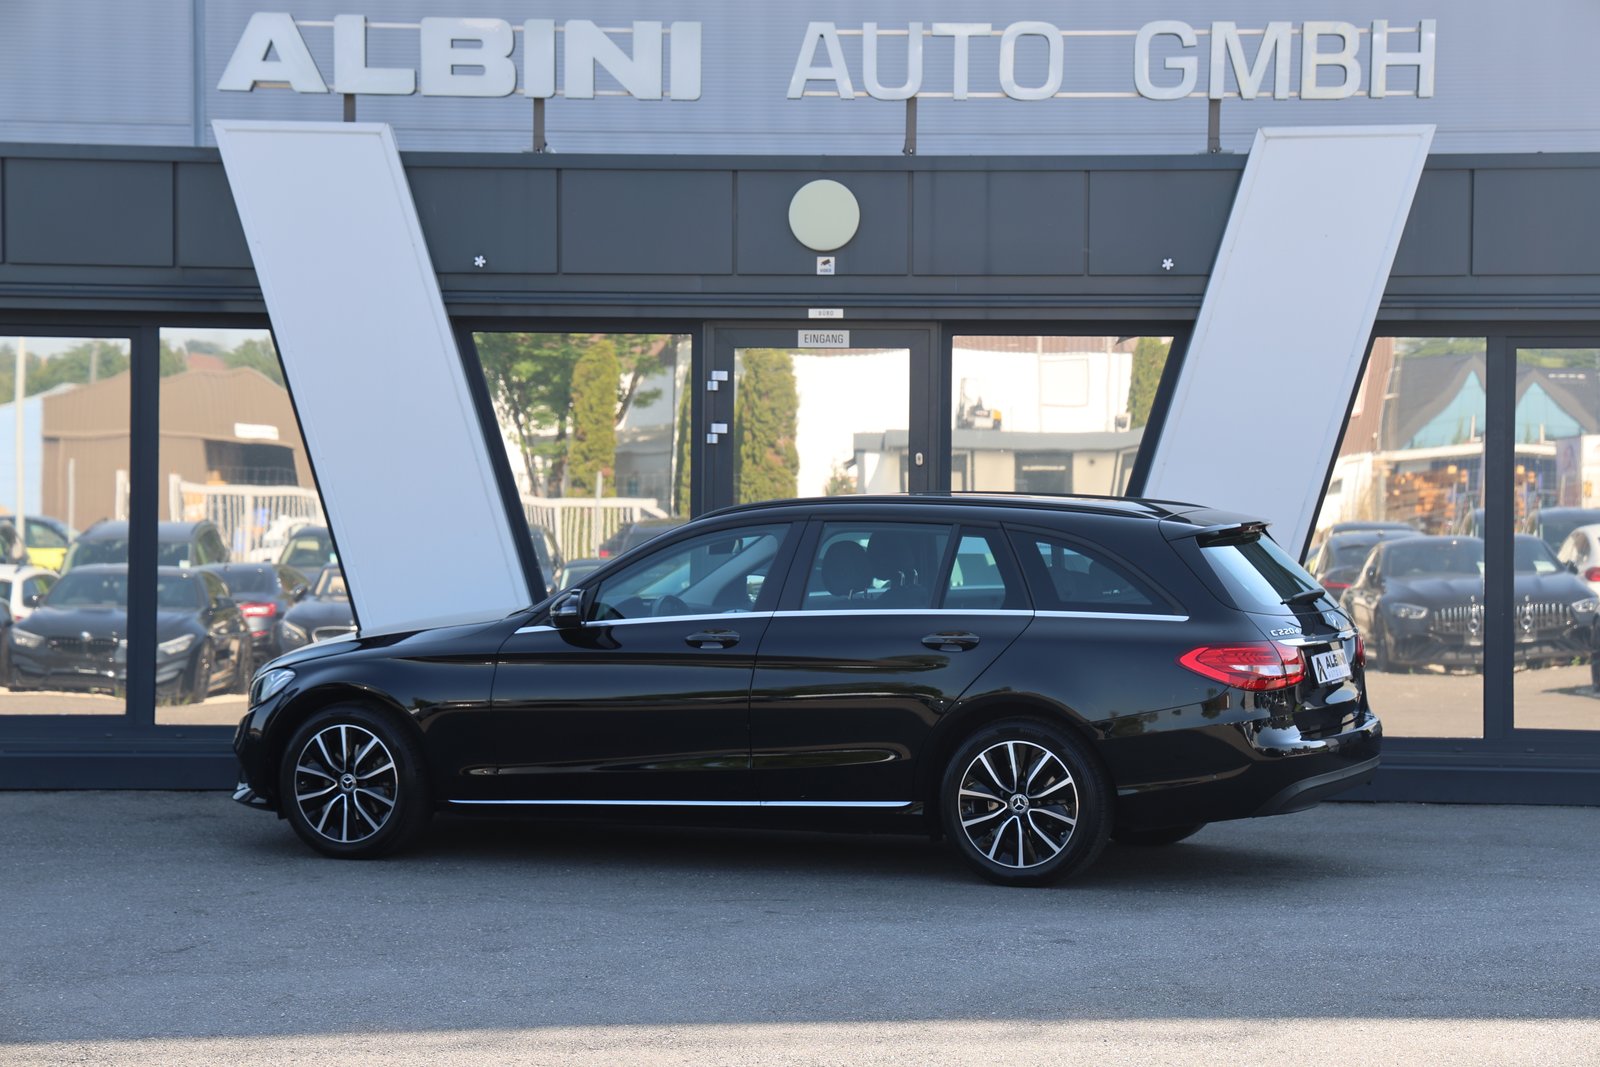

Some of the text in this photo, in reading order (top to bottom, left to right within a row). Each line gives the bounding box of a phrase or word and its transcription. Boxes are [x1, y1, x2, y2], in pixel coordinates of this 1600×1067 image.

[217, 12, 1437, 101] ALBINI AUTO GMBH
[804, 333, 844, 344] EINGANG
